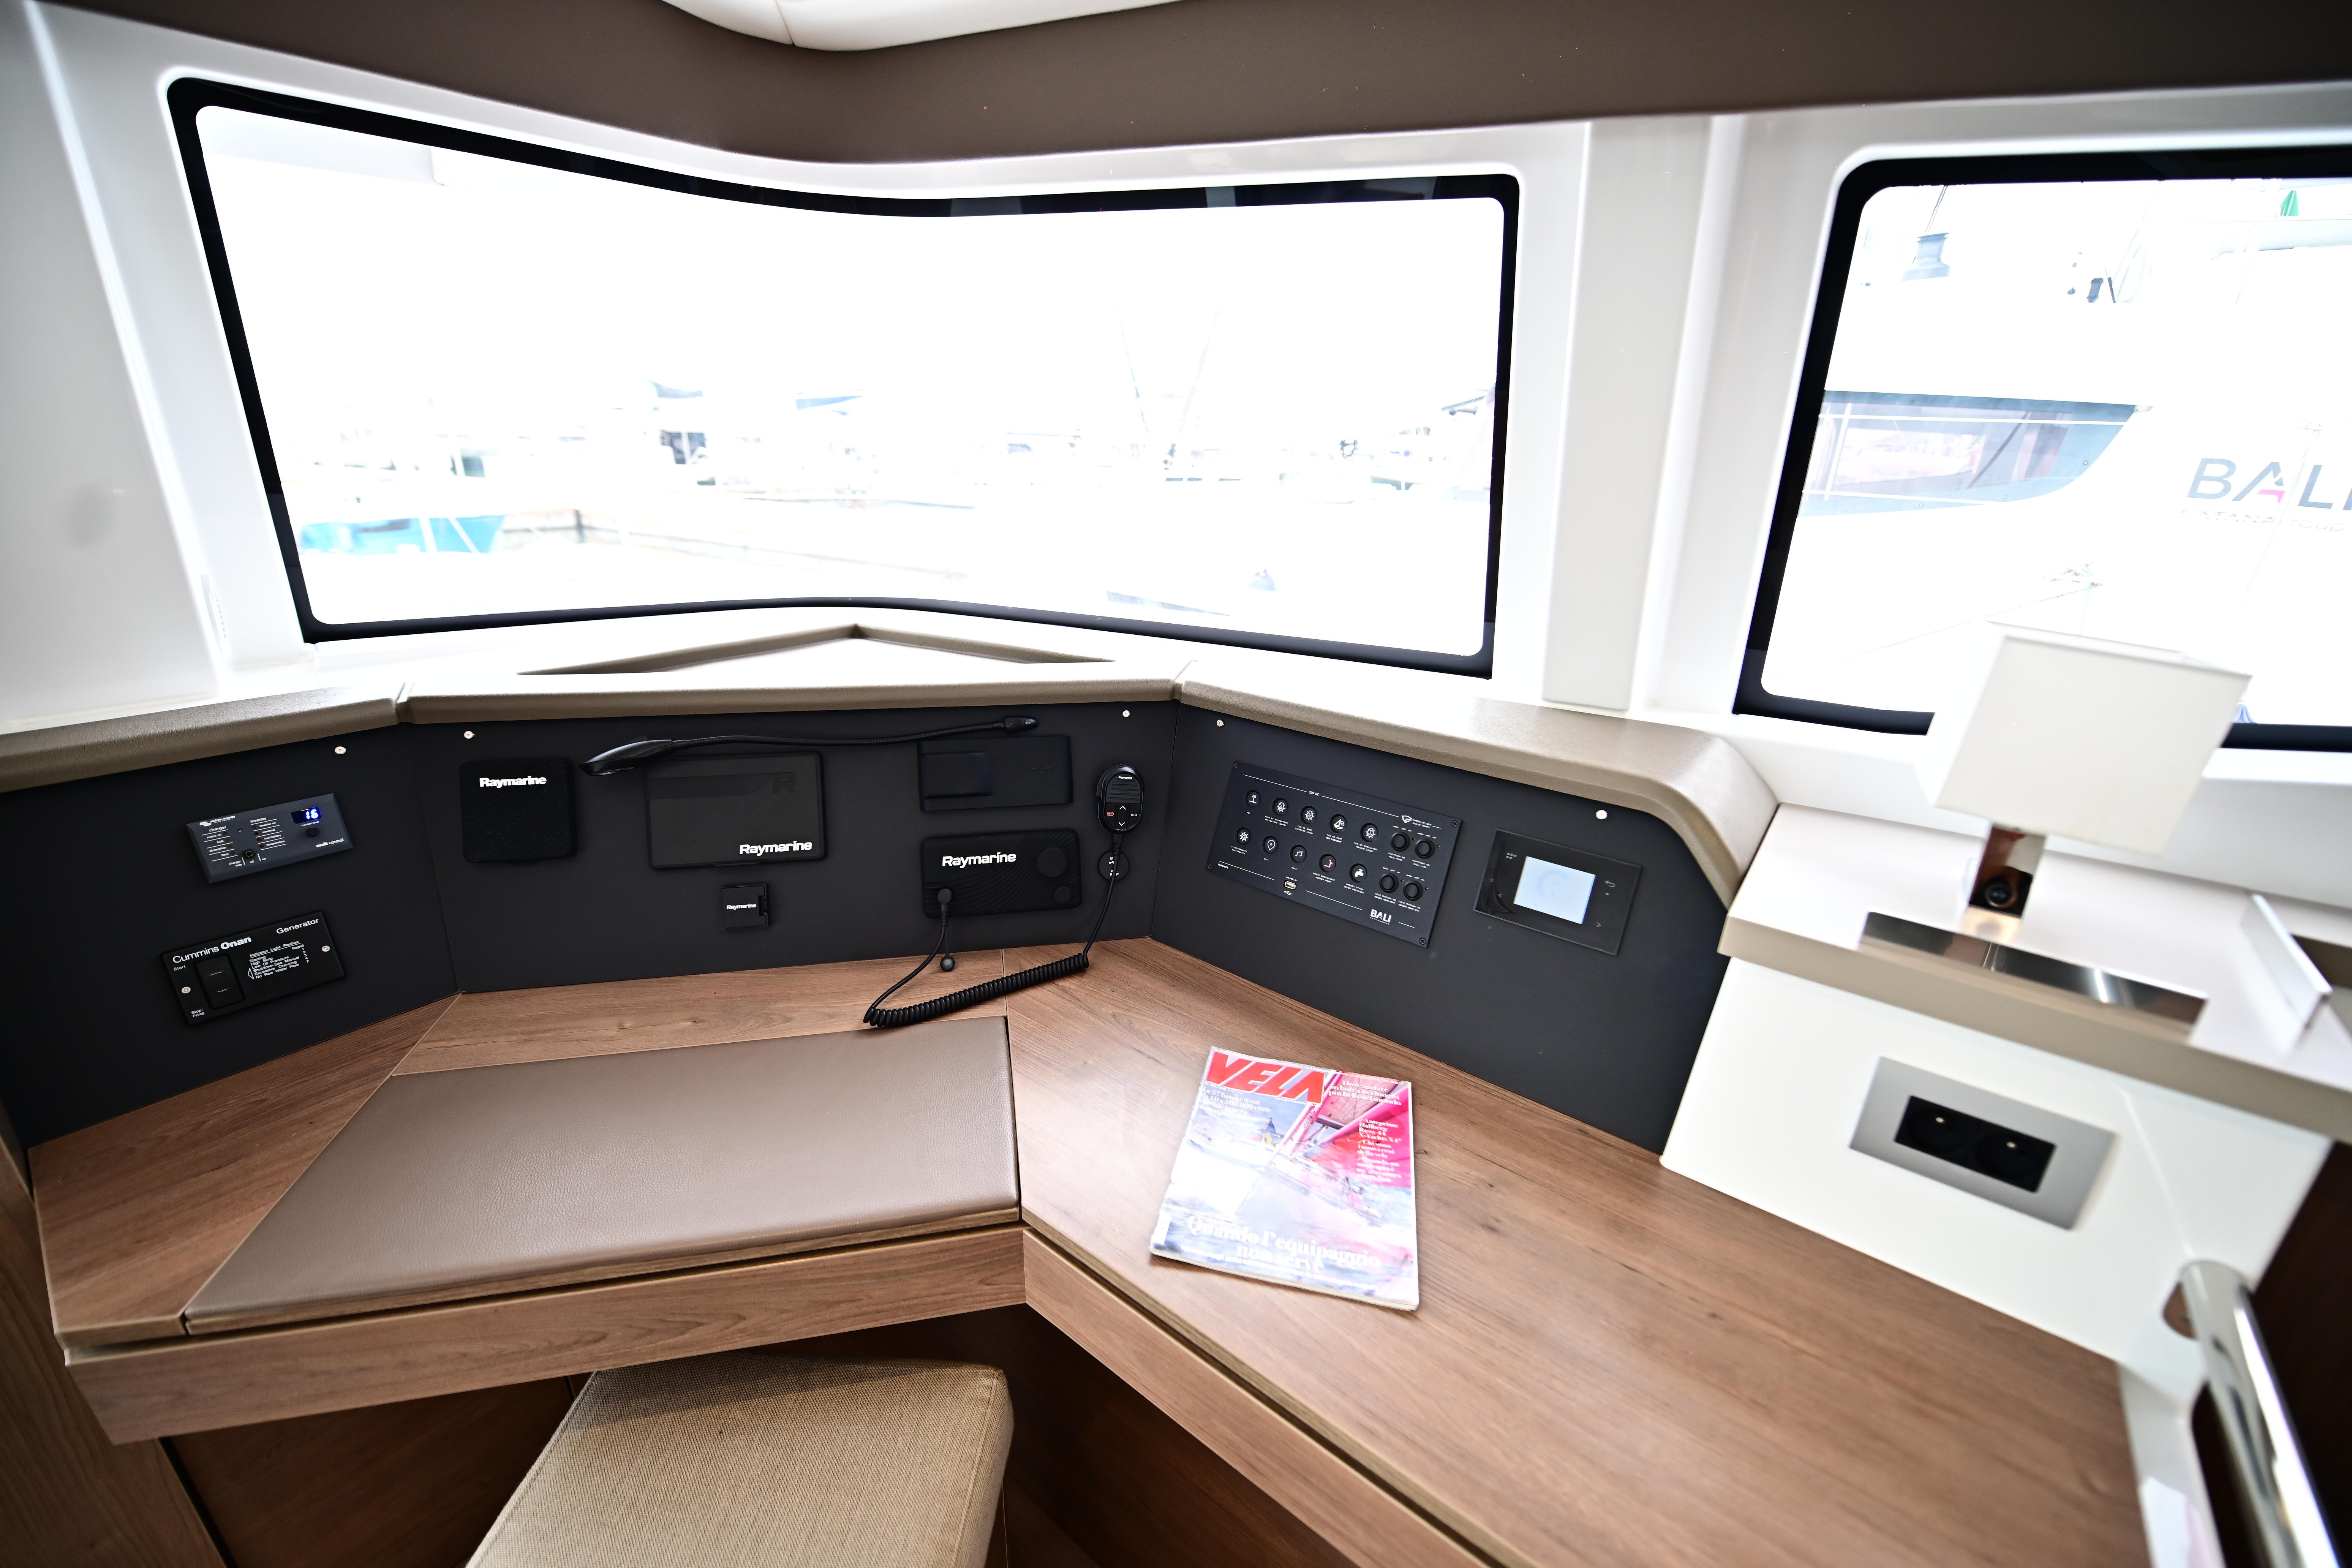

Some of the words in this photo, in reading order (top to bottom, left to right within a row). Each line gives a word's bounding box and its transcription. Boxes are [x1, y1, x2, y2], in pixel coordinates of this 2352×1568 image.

[479, 776, 547, 788] Raymarine
[739, 841, 813, 856] Raymarine
[942, 852, 1016, 869] Raymarine
[1370, 909, 1392, 923] BALI
[276, 919, 319, 934] Generator
[172, 946, 220, 963] Cummins
[220, 937, 252, 950] Onan
[254, 967, 275, 976] Excessive
[1206, 1051, 1326, 1104] VELA
[1340, 1086, 1360, 1095] barca
[1374, 1090, 1399, 1100] luoghi
[1342, 1080, 1362, 1089] Dove
[1361, 1083, 1389, 1092] andare
[1221, 1091, 1244, 1102] barche
[1244, 1097, 1261, 1105] usate
[1224, 1099, 1254, 1110] 300.000
[1342, 1091, 1359, 1099] belli
[1373, 1097, 1401, 1106] mondo
[1359, 1122, 1387, 1132] Hallberg
[1365, 1118, 1398, 1129] Anteprime
[1187, 1214, 1260, 1244] Quando
[1261, 1230, 1381, 1269] l'equipaggio
[1236, 1244, 1273, 1263] non
[1275, 1252, 1324, 1274] serve
